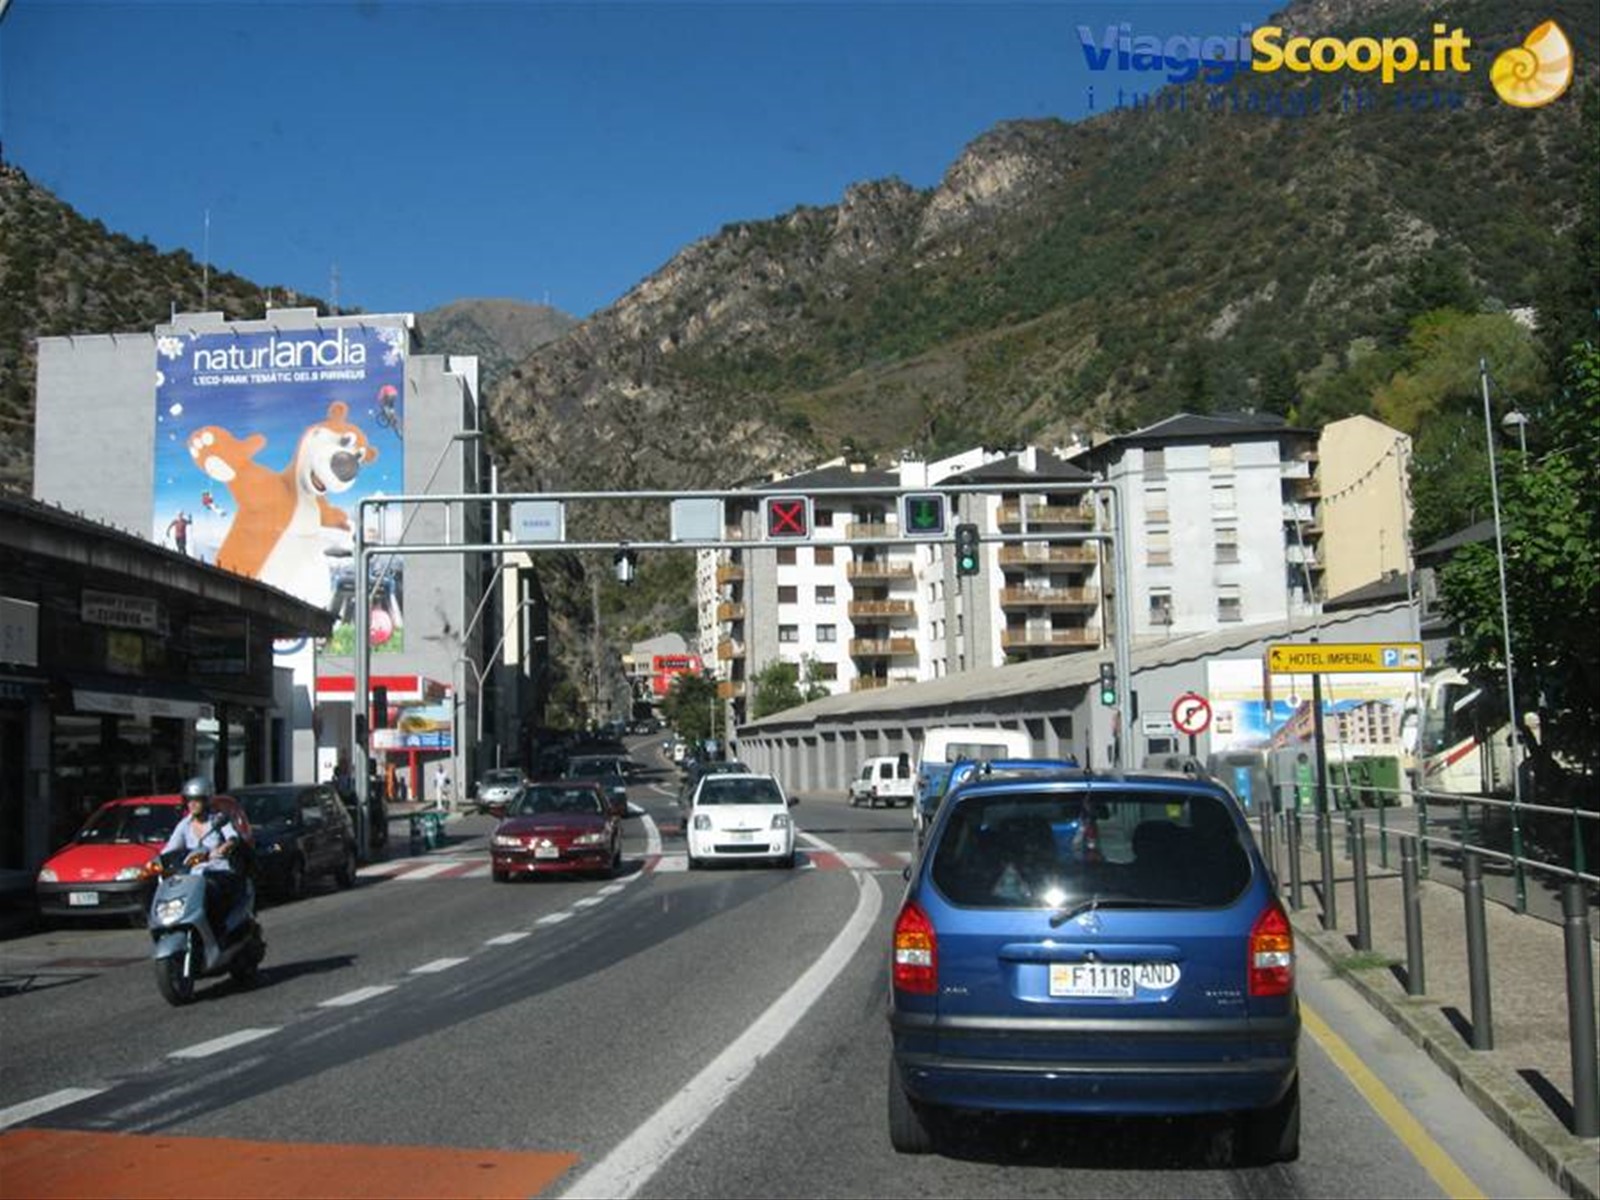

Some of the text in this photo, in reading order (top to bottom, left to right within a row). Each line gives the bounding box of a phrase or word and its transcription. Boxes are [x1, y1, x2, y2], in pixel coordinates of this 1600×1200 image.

[193, 327, 366, 371] naturlandia
[1289, 652, 1324, 665] HOTEL
[1327, 651, 1375, 665] IMPERIAL
[1073, 967, 1131, 988] F1118
[1140, 963, 1175, 984] AND
